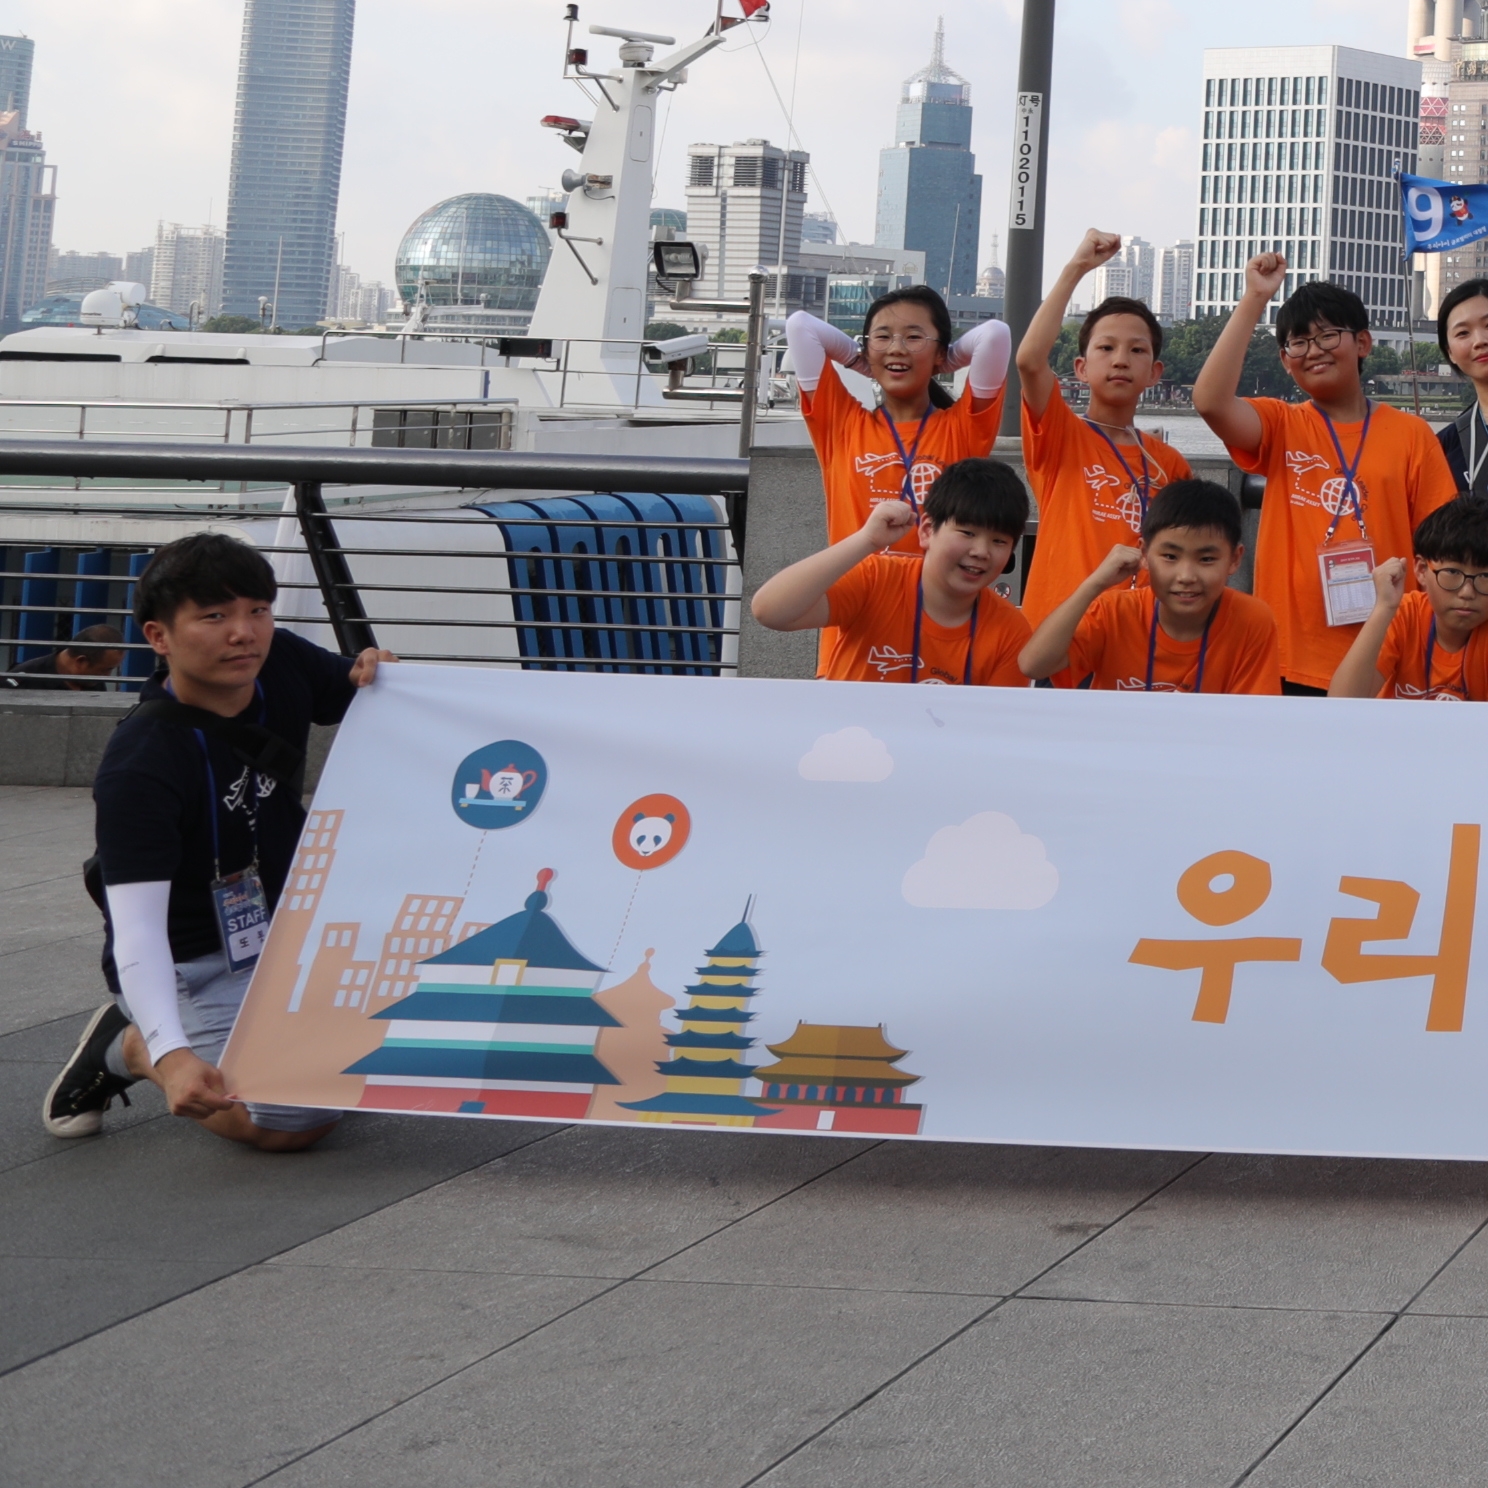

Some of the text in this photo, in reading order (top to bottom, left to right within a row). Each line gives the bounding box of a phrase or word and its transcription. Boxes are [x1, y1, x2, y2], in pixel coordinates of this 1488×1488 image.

[1015, 115, 1032, 226] 11020115
[1408, 186, 1444, 242] 9
[930, 666, 958, 682] Global
[498, 776, 514, 795] 茶
[227, 906, 266, 933] STAFF
